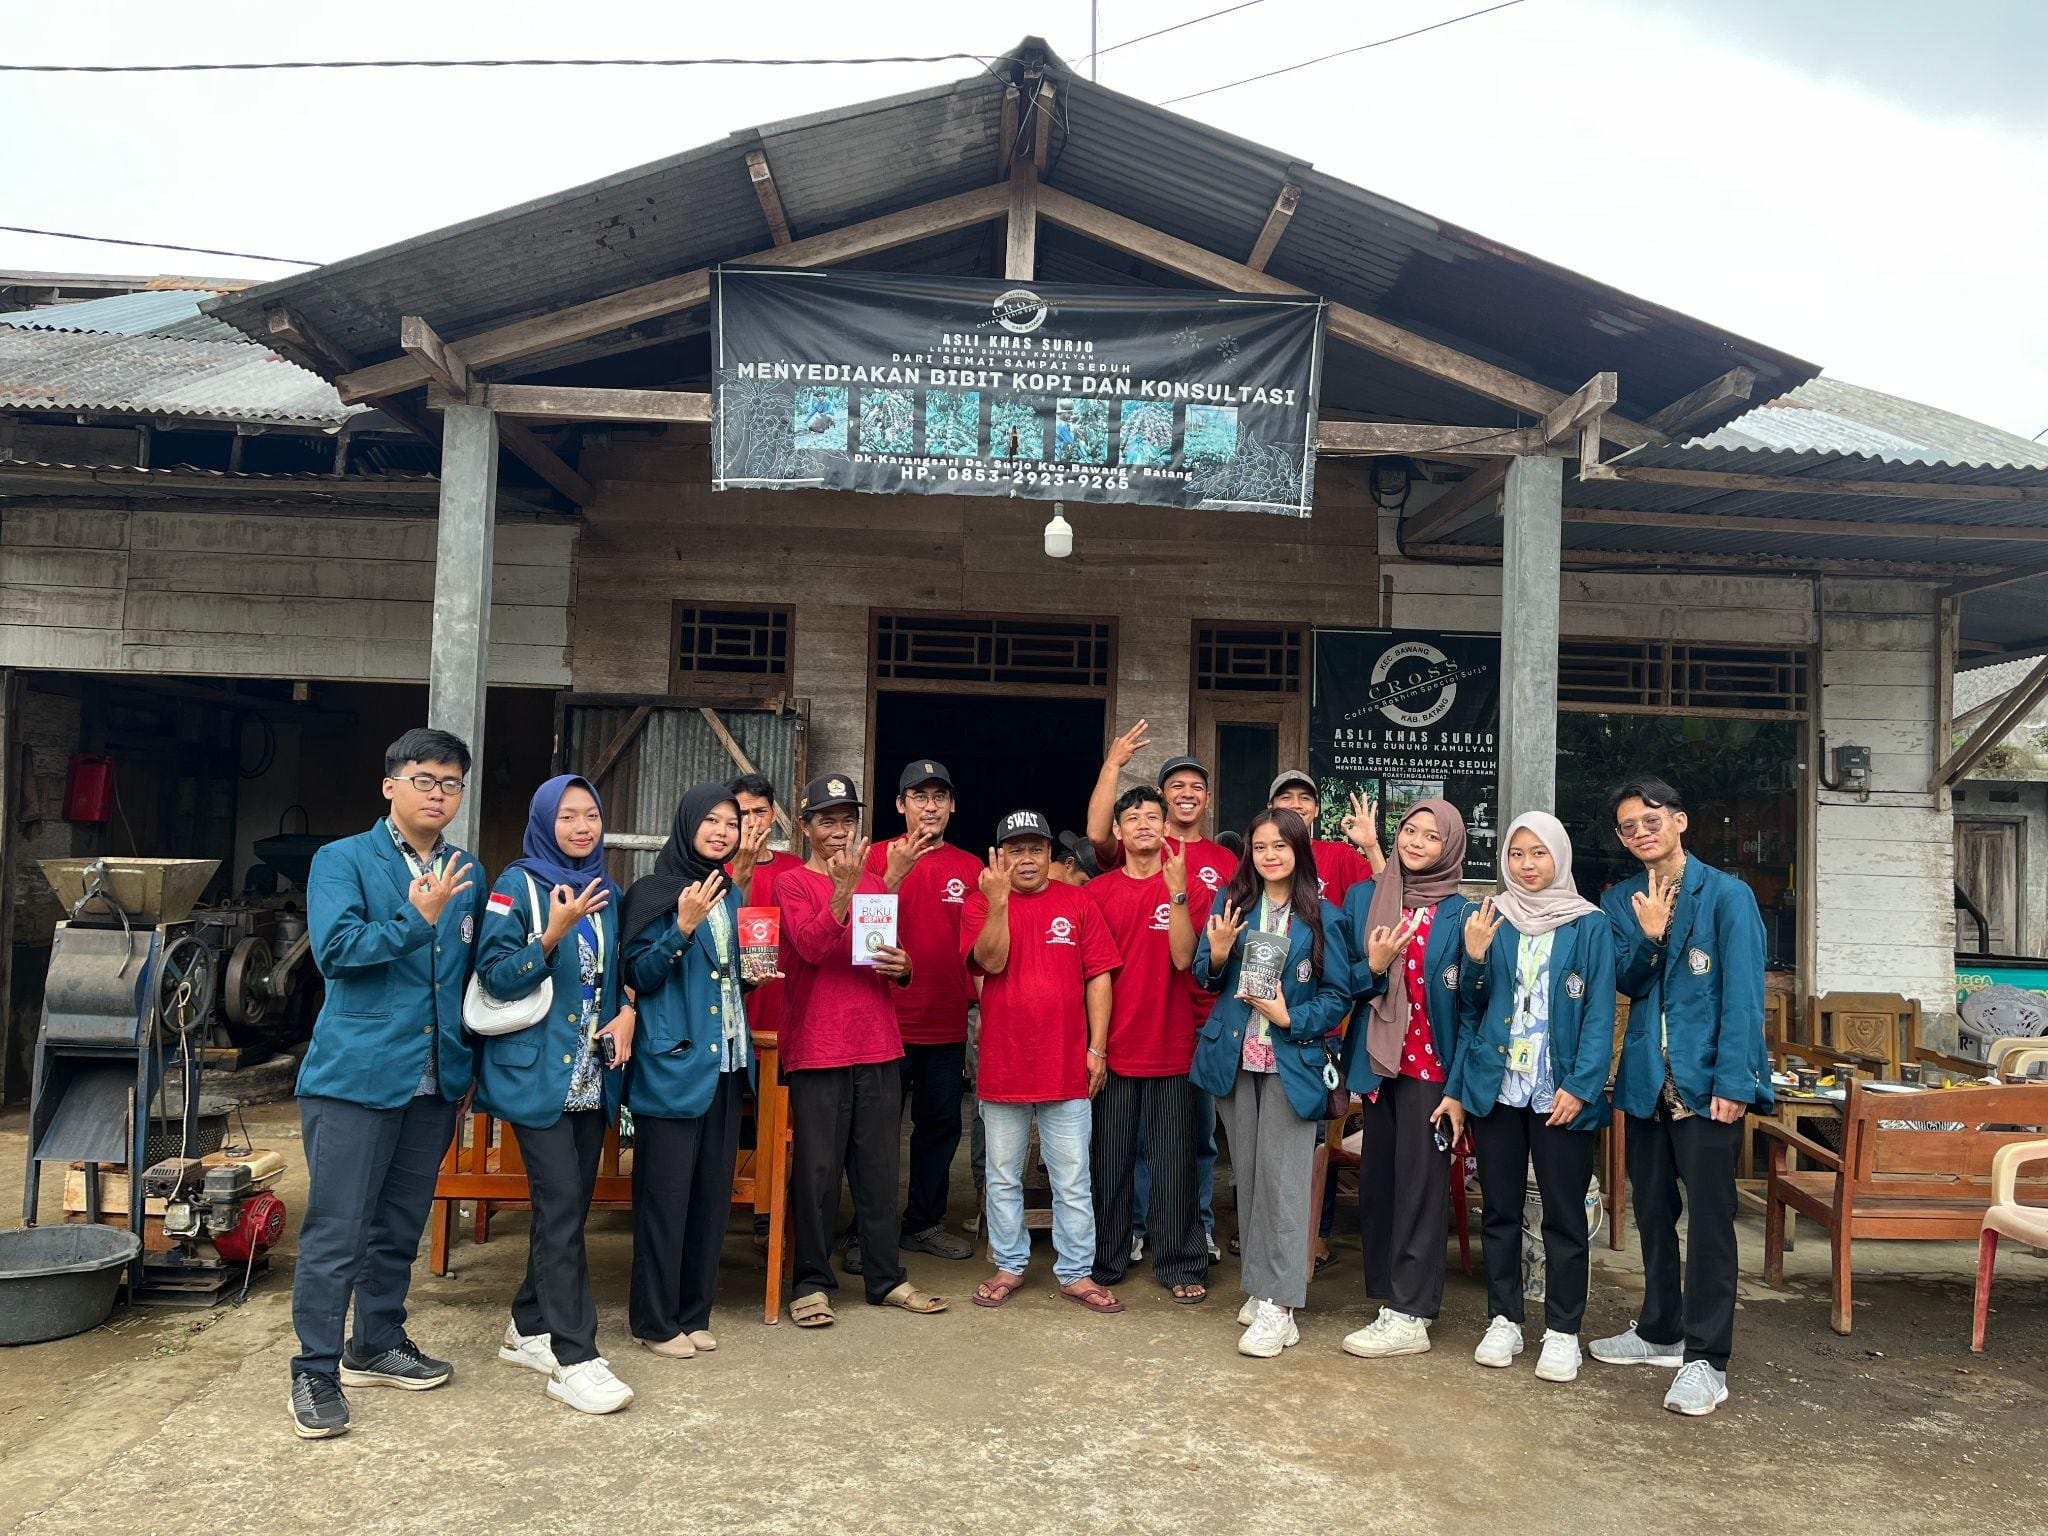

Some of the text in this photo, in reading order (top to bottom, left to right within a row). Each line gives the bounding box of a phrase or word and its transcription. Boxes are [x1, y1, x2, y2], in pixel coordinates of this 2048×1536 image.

[942, 333, 1093, 353] ASLI KHAS SURJO
[930, 346, 1094, 361] LERENG GUNUNG KAMULYAN
[892, 353, 1130, 374] DARI SEMAI SAMPAI SEDUH
[737, 362, 1295, 406] MENYEDIAKAN BIBIT KOPI DAN KONSULTASI
[901, 466, 1129, 490] HP. 0853-2923-9265
[965, 458, 988, 468] Ds.
[994, 459, 1031, 471] Surjo
[1143, 467, 1193, 481] Batang
[1394, 646, 1430, 656] BAWANG
[1368, 659, 1458, 700] CROSS
[1461, 665, 1487, 678] Surjo
[1422, 697, 1449, 721] BATANG
[1334, 728, 1493, 745] ASLI KHAS SURJO
[1333, 741, 1493, 753] LERENG GUNUNG KAMULYAN
[1334, 755, 1363, 764] DARI
[1409, 758, 1454, 768] SAMPAI
[1458, 760, 1497, 769] SEDUH
[1006, 811, 1039, 830] SWAT
[862, 906, 891, 917] BUKU
